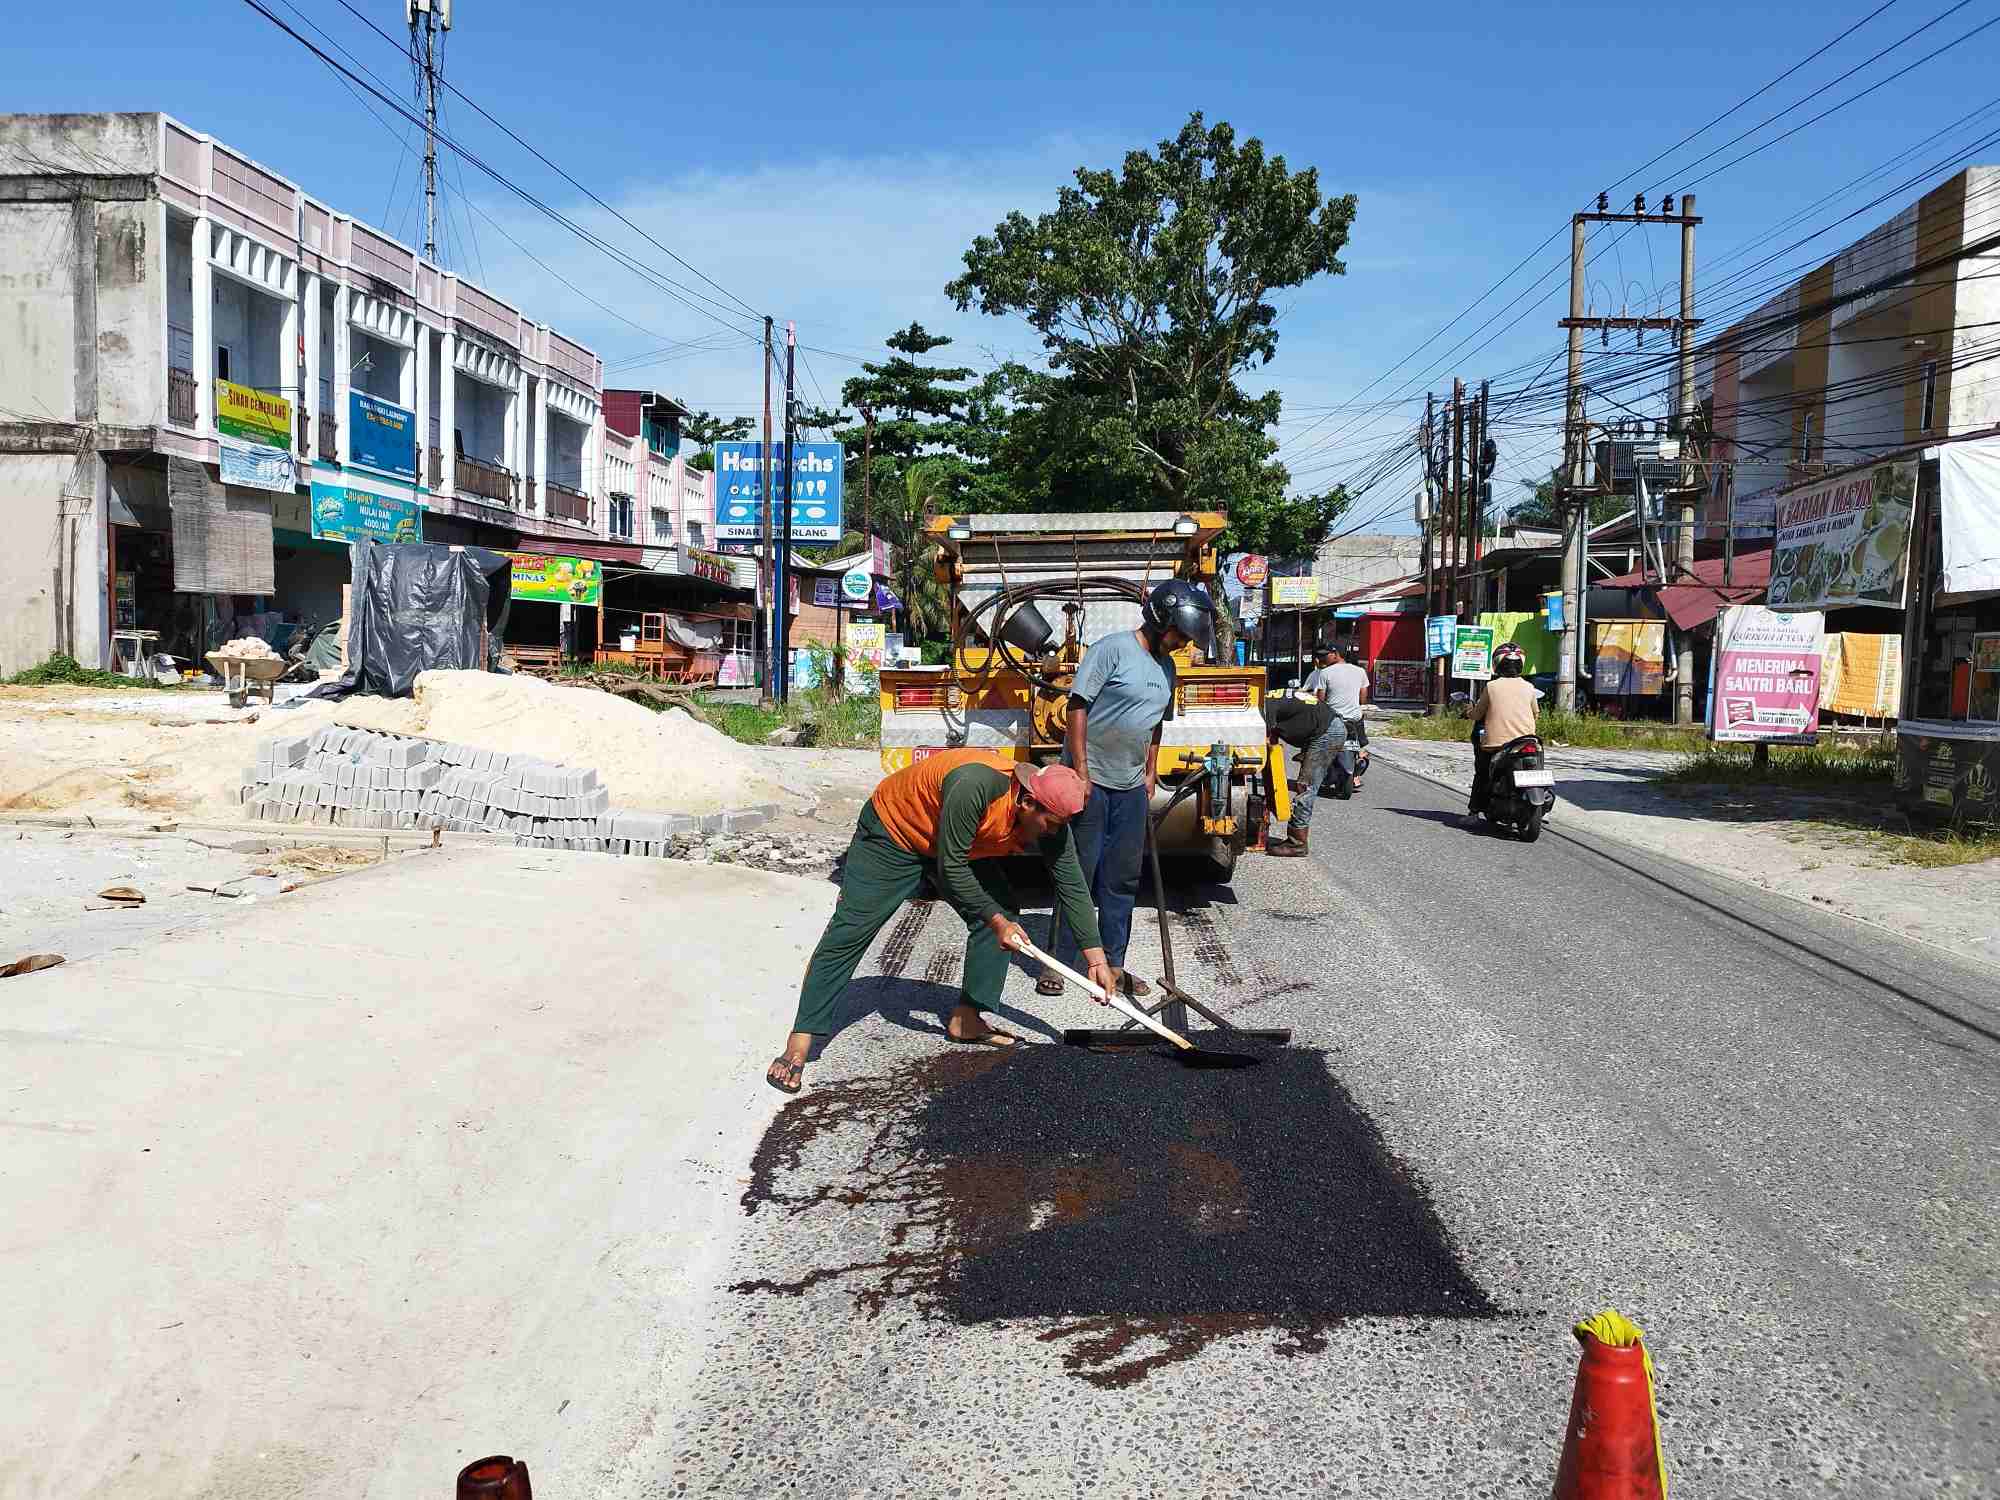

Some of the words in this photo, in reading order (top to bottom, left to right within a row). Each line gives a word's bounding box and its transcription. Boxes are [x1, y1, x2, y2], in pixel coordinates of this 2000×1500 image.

[228, 389, 249, 409] SINAR
[727, 527, 761, 536] SINAR
[765, 527, 828, 538] EMRLANG
[1735, 658, 1806, 674] MENERIMA
[1725, 676, 1774, 692] SANTRI
[1775, 678, 1814, 695] BARU
